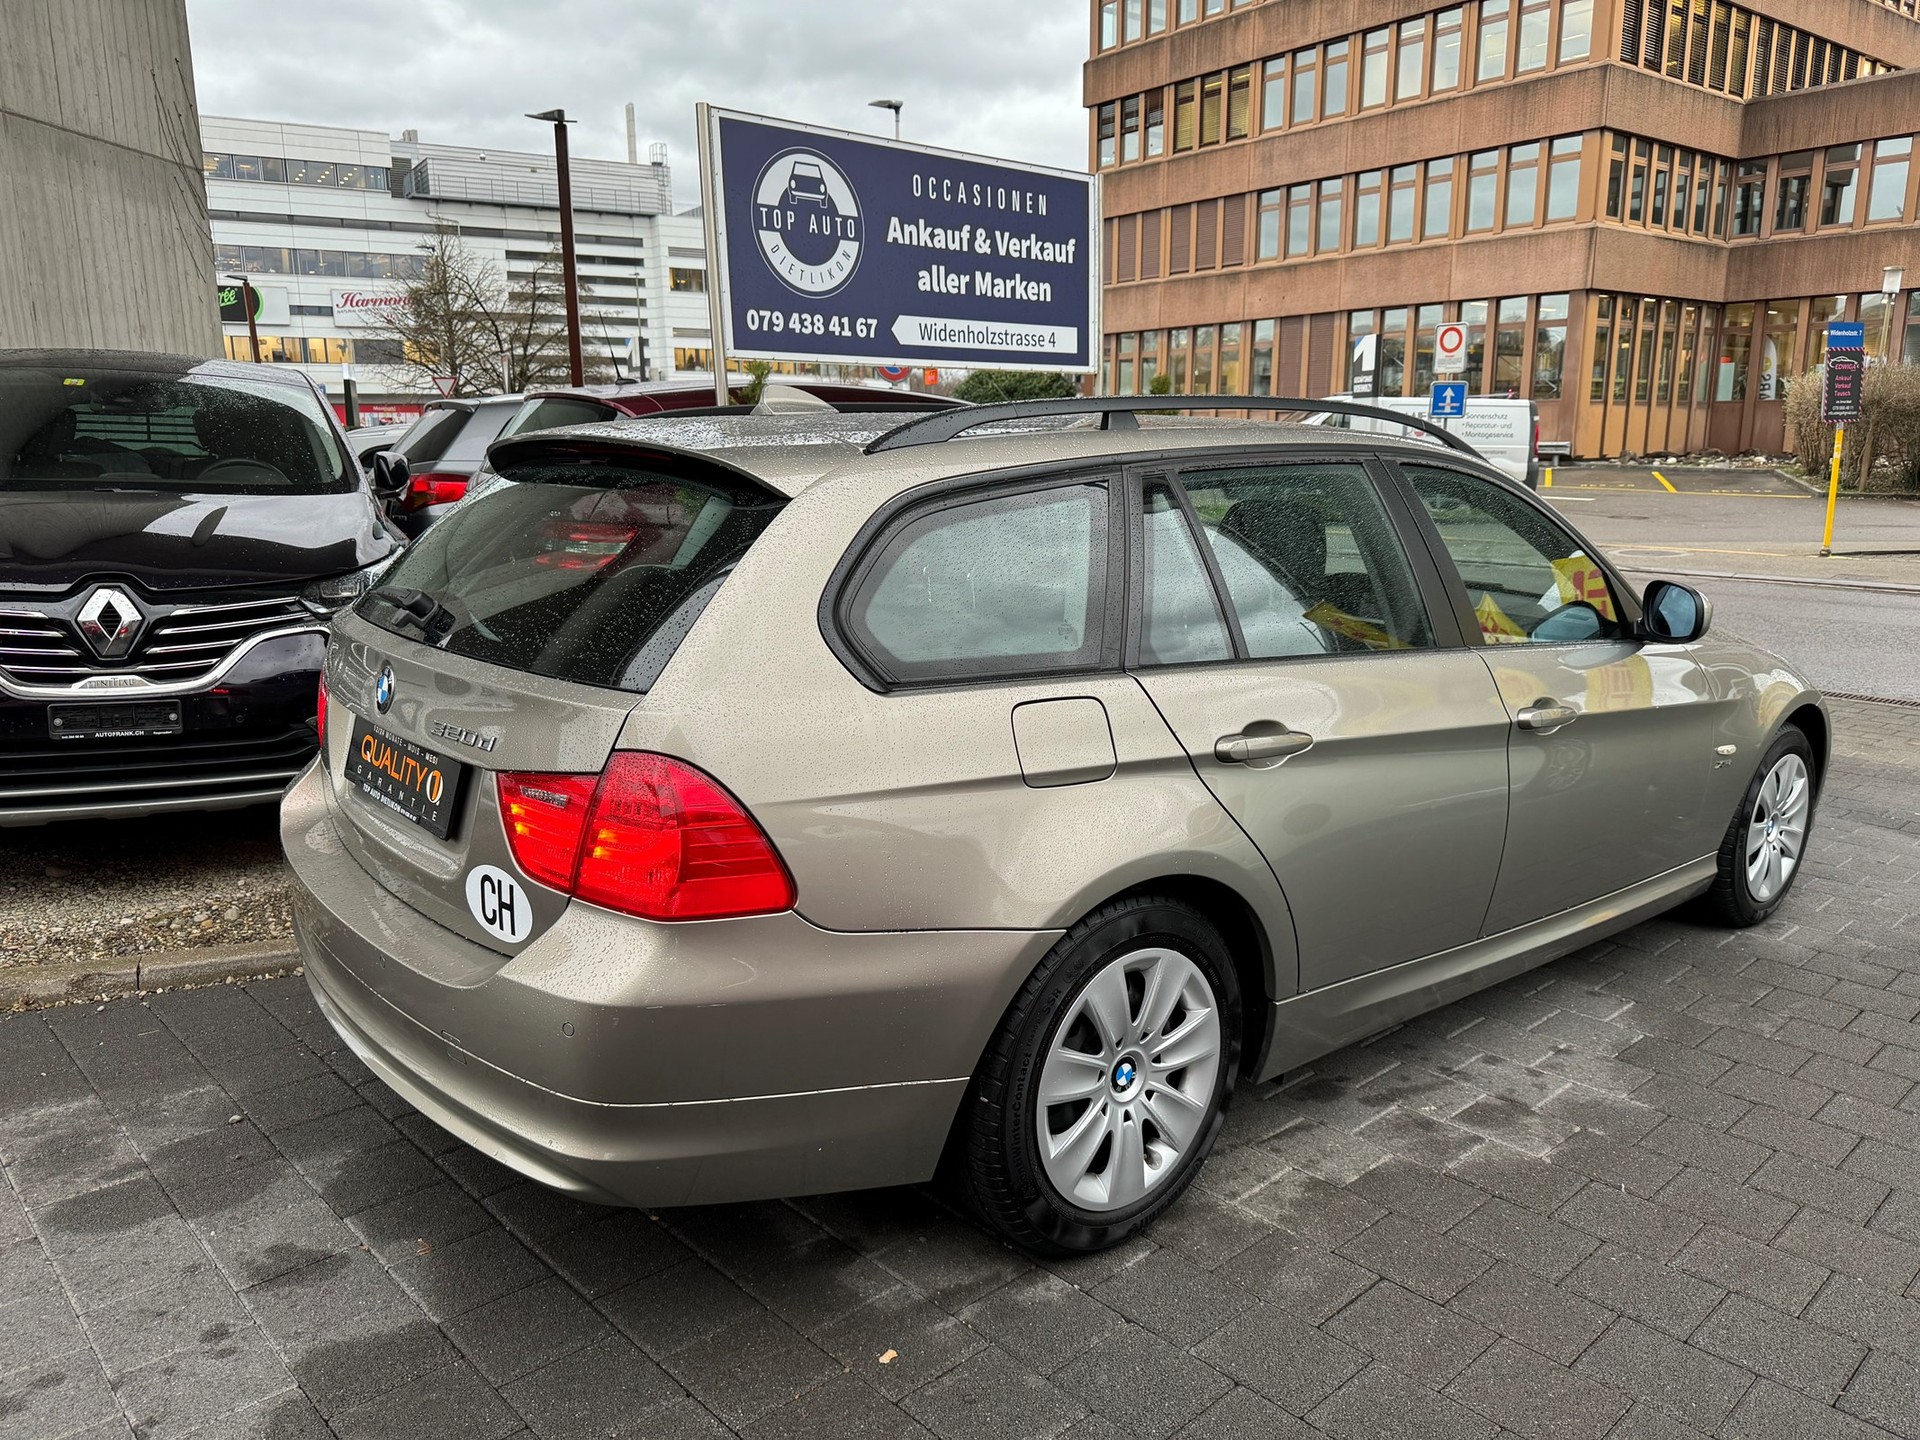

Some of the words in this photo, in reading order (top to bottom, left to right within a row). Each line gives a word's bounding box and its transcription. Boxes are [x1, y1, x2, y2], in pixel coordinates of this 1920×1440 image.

[912, 173, 1048, 216] OCCASIONEN
[760, 206, 796, 231] TOP
[809, 213, 856, 239] AUTO
[886, 216, 971, 252] Ankauf
[974, 227, 992, 255] &
[994, 230, 1076, 264] Verkauf
[770, 244, 852, 285] DIETLIKON
[917, 264, 970, 295] aller
[974, 270, 1051, 302] Marken
[746, 309, 784, 333] 079
[788, 312, 824, 336] 438
[828, 315, 852, 338] 41
[855, 318, 878, 339] 67
[918, 322, 1045, 347] Widenholzstrasse
[1047, 331, 1057, 348] 4
[95, 730, 145, 738] AUTOFRANK.CH
[431, 719, 497, 752] 320d
[360, 734, 428, 792] QUALITY
[357, 764, 438, 822] GARANTIE
[480, 873, 517, 937] CH
